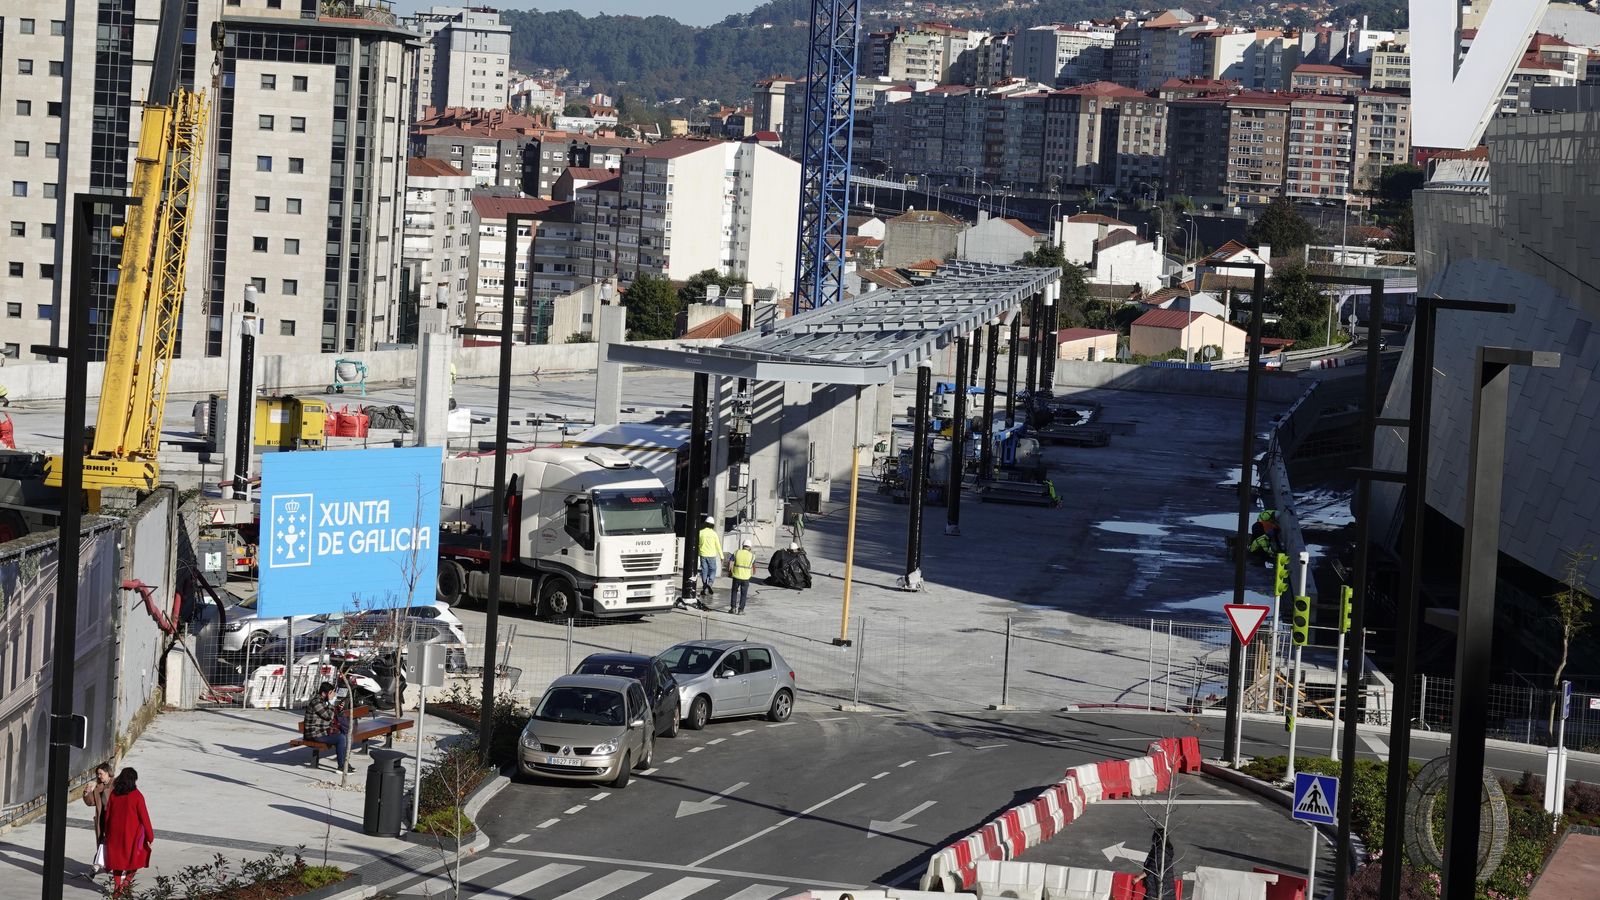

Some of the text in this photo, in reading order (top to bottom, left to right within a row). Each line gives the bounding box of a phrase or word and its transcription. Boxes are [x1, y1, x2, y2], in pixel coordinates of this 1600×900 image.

[319, 500, 390, 527] XUNTA
[318, 526, 430, 555] DE GALICIA
